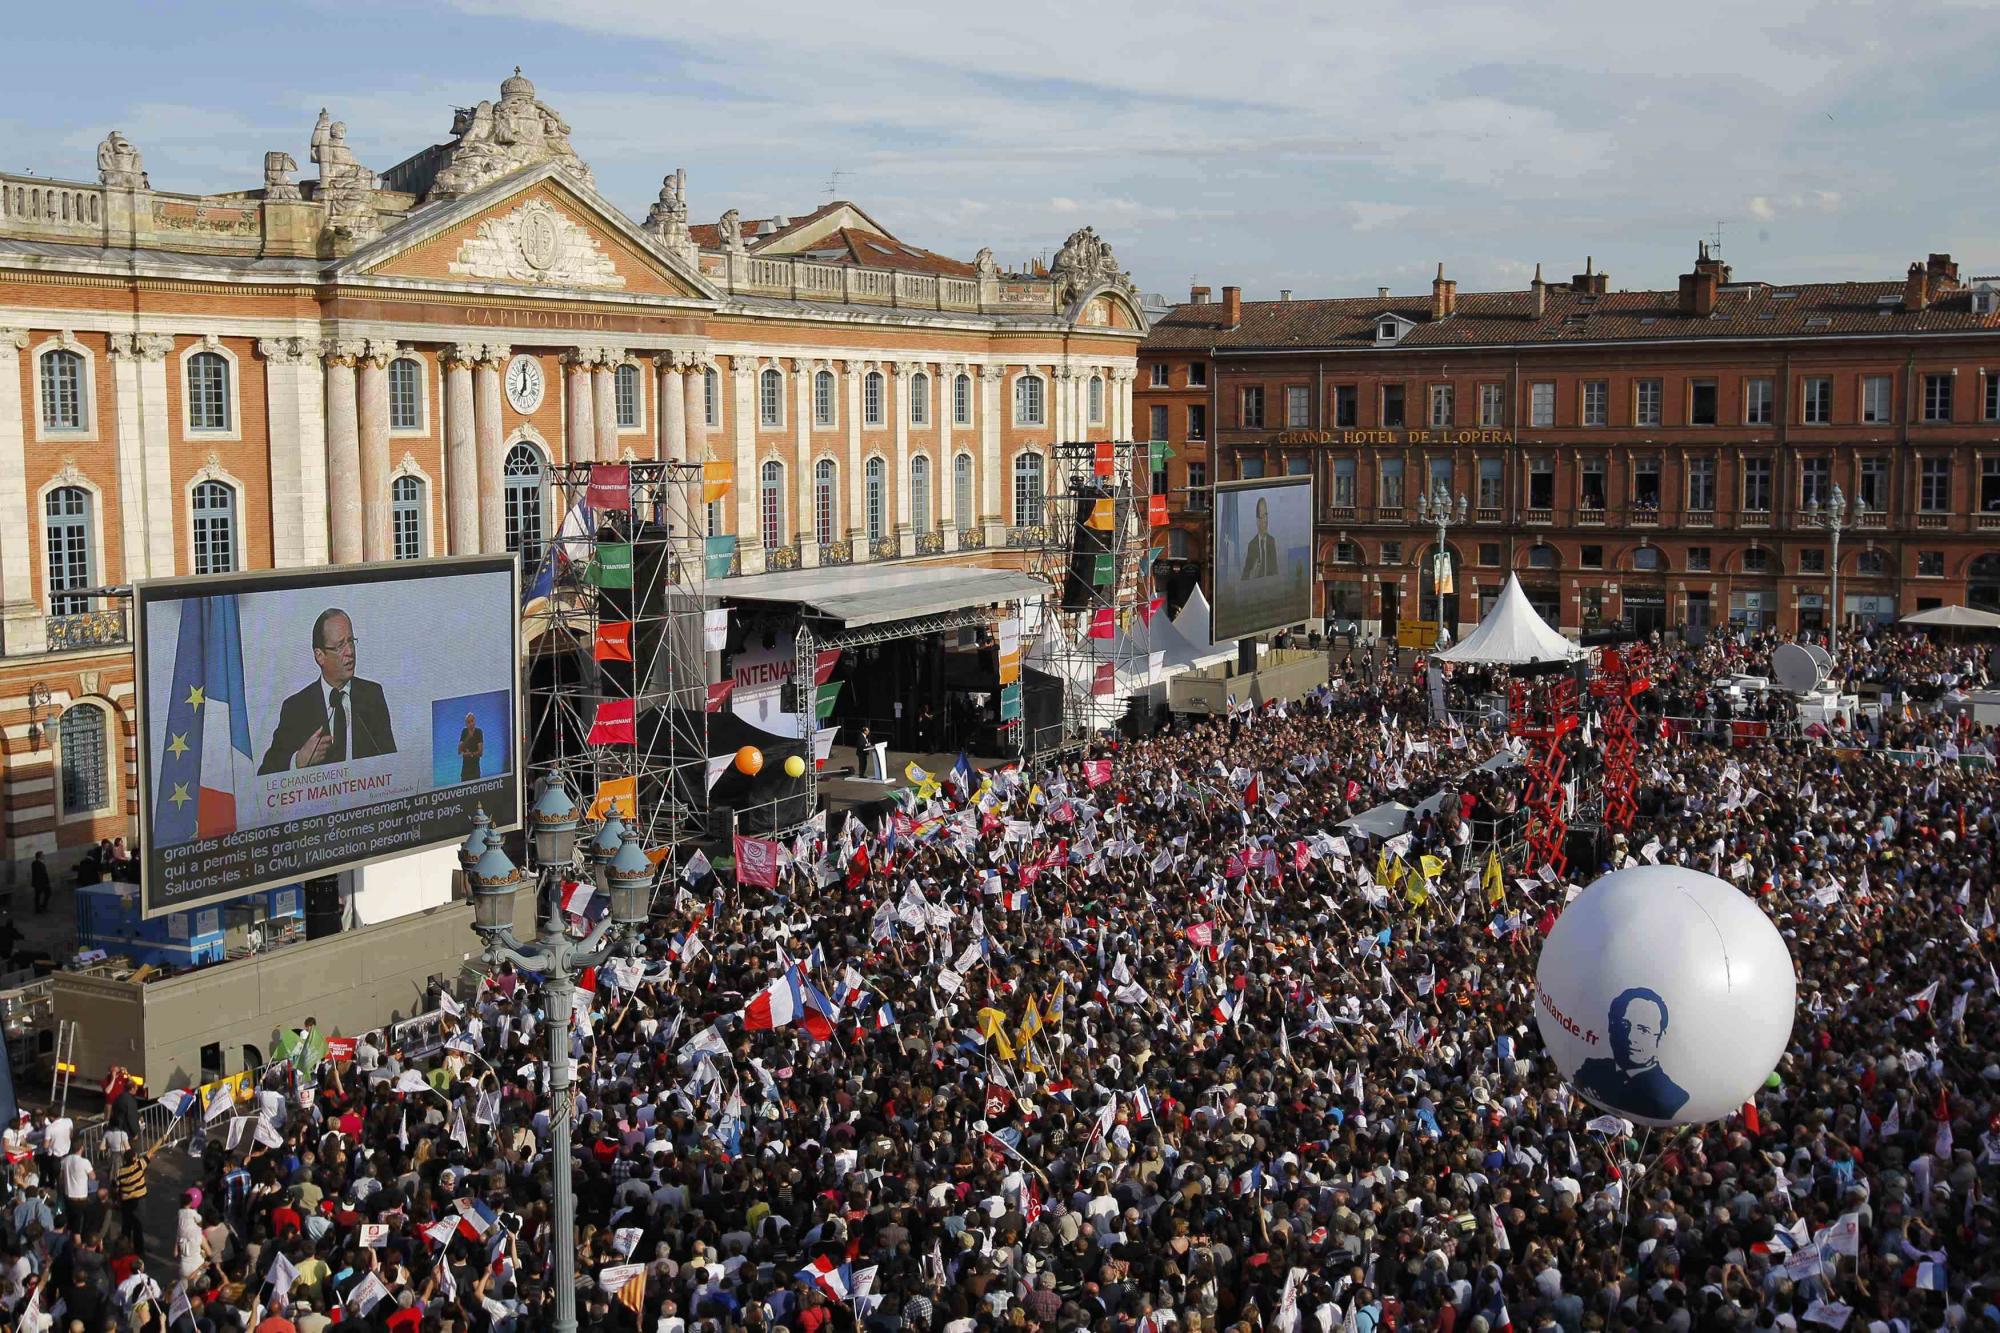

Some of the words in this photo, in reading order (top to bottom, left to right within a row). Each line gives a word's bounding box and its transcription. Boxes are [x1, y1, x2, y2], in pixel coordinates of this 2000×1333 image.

[466, 308, 603, 329] CAPITOLIUM
[1278, 431, 1330, 443] GRAND
[1344, 431, 1397, 443] HOTEL
[1409, 431, 1430, 443] DE
[732, 657, 797, 689] INTENAN
[266, 780, 277, 791] LE
[280, 767, 349, 788] CHANGEMENT
[266, 789, 304, 808] C'EST
[307, 773, 392, 801] MAINTENANT
[164, 839, 218, 862] grandes
[222, 828, 280, 848] décisions
[284, 822, 299, 834] de
[302, 816, 324, 830] son
[327, 799, 412, 828] gouvernement,
[414, 793, 428, 806] un
[431, 779, 504, 806] gouvernement
[164, 861, 186, 880] qui
[190, 861, 199, 873] a
[203, 849, 247, 872] permis
[251, 846, 268, 860] les
[272, 833, 321, 858] grandes
[324, 820, 375, 843] réformes
[378, 815, 403, 833] pour
[406, 809, 434, 825] notre
[437, 803, 464, 819] pays.
[165, 870, 241, 896] Saluons-les
[254, 863, 265, 876] la
[268, 855, 301, 873] CMU,
[305, 840, 366, 865] l'Allocation
[1535, 981, 1600, 1046] hollande.fr
